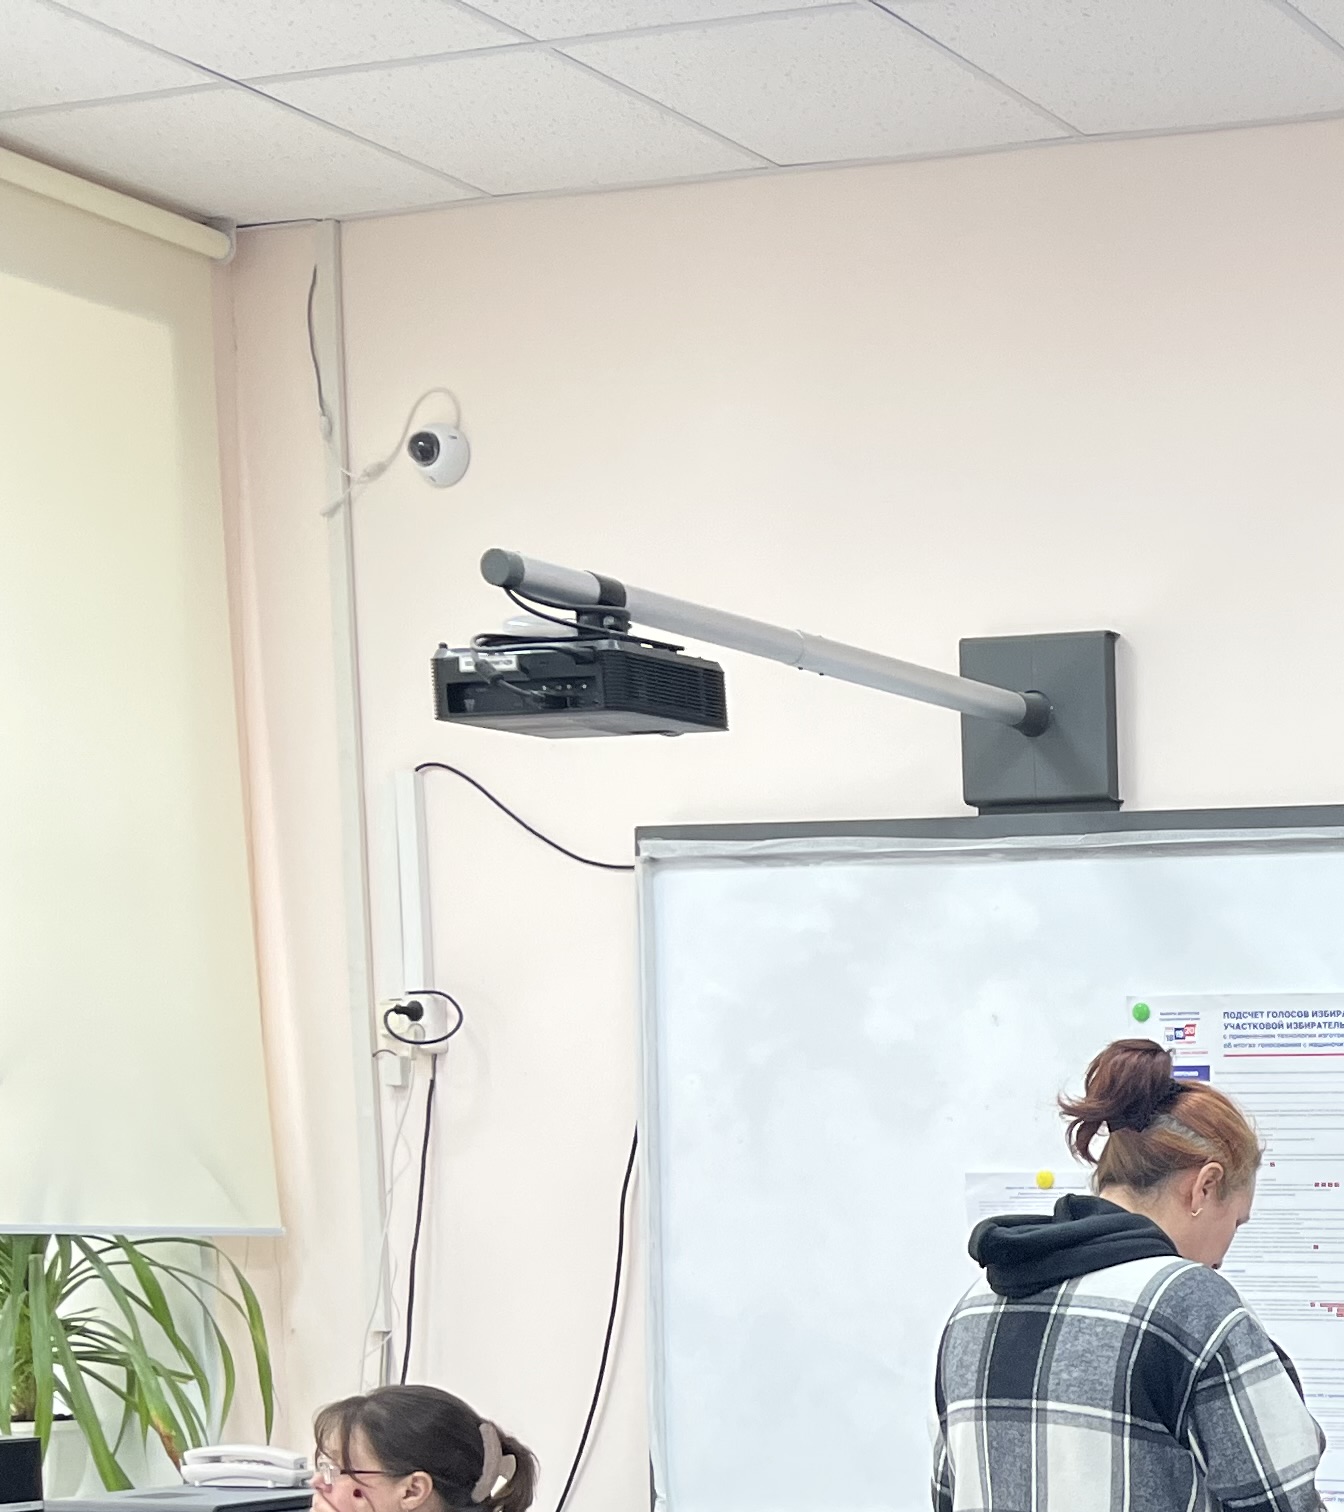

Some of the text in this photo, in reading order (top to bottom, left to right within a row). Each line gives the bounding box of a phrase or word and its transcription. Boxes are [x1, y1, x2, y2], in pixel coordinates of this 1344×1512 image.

[1223, 1011, 1264, 1020] ПОДСЧЕТ
[1267, 1010, 1309, 1018] ГОЛОСОВ
[1224, 1020, 1284, 1030] УЧАСТКОВОЙ
